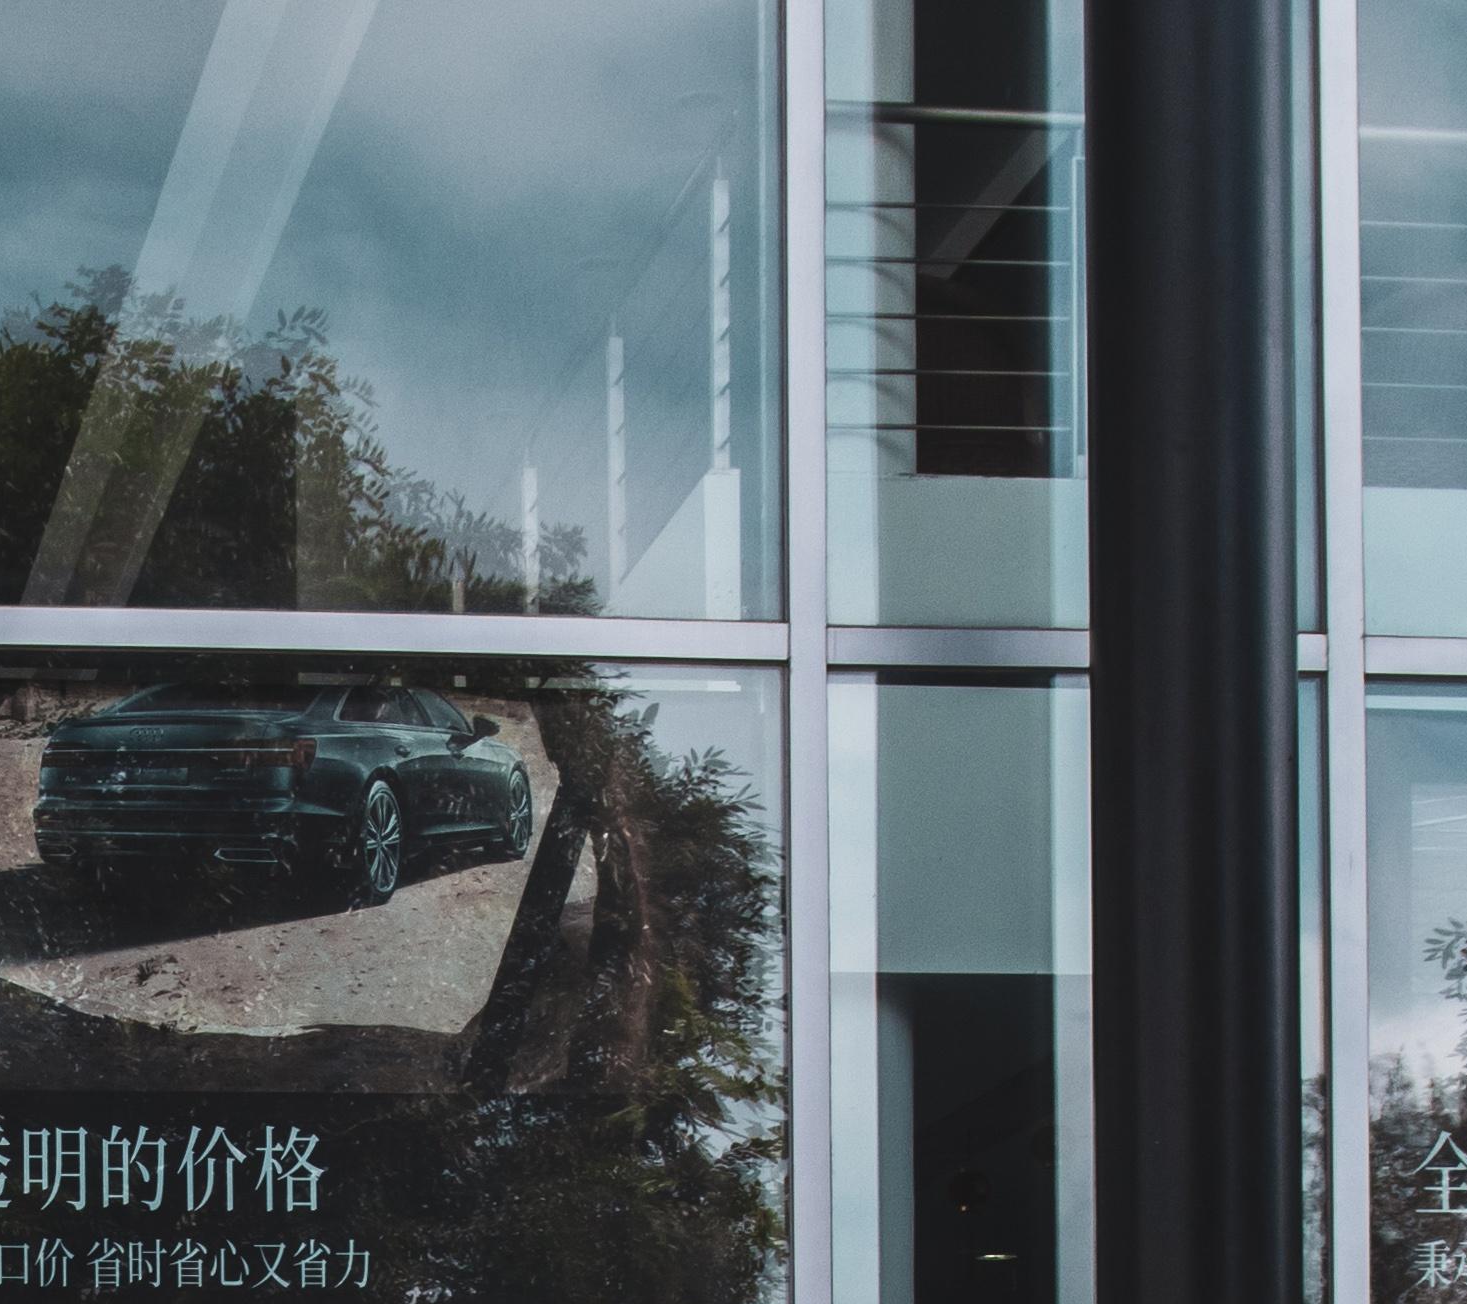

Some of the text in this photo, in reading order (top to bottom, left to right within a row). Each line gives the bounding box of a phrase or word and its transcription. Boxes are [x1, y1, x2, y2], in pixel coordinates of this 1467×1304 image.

[86, 1237, 372, 1289] 省时省心又省力
